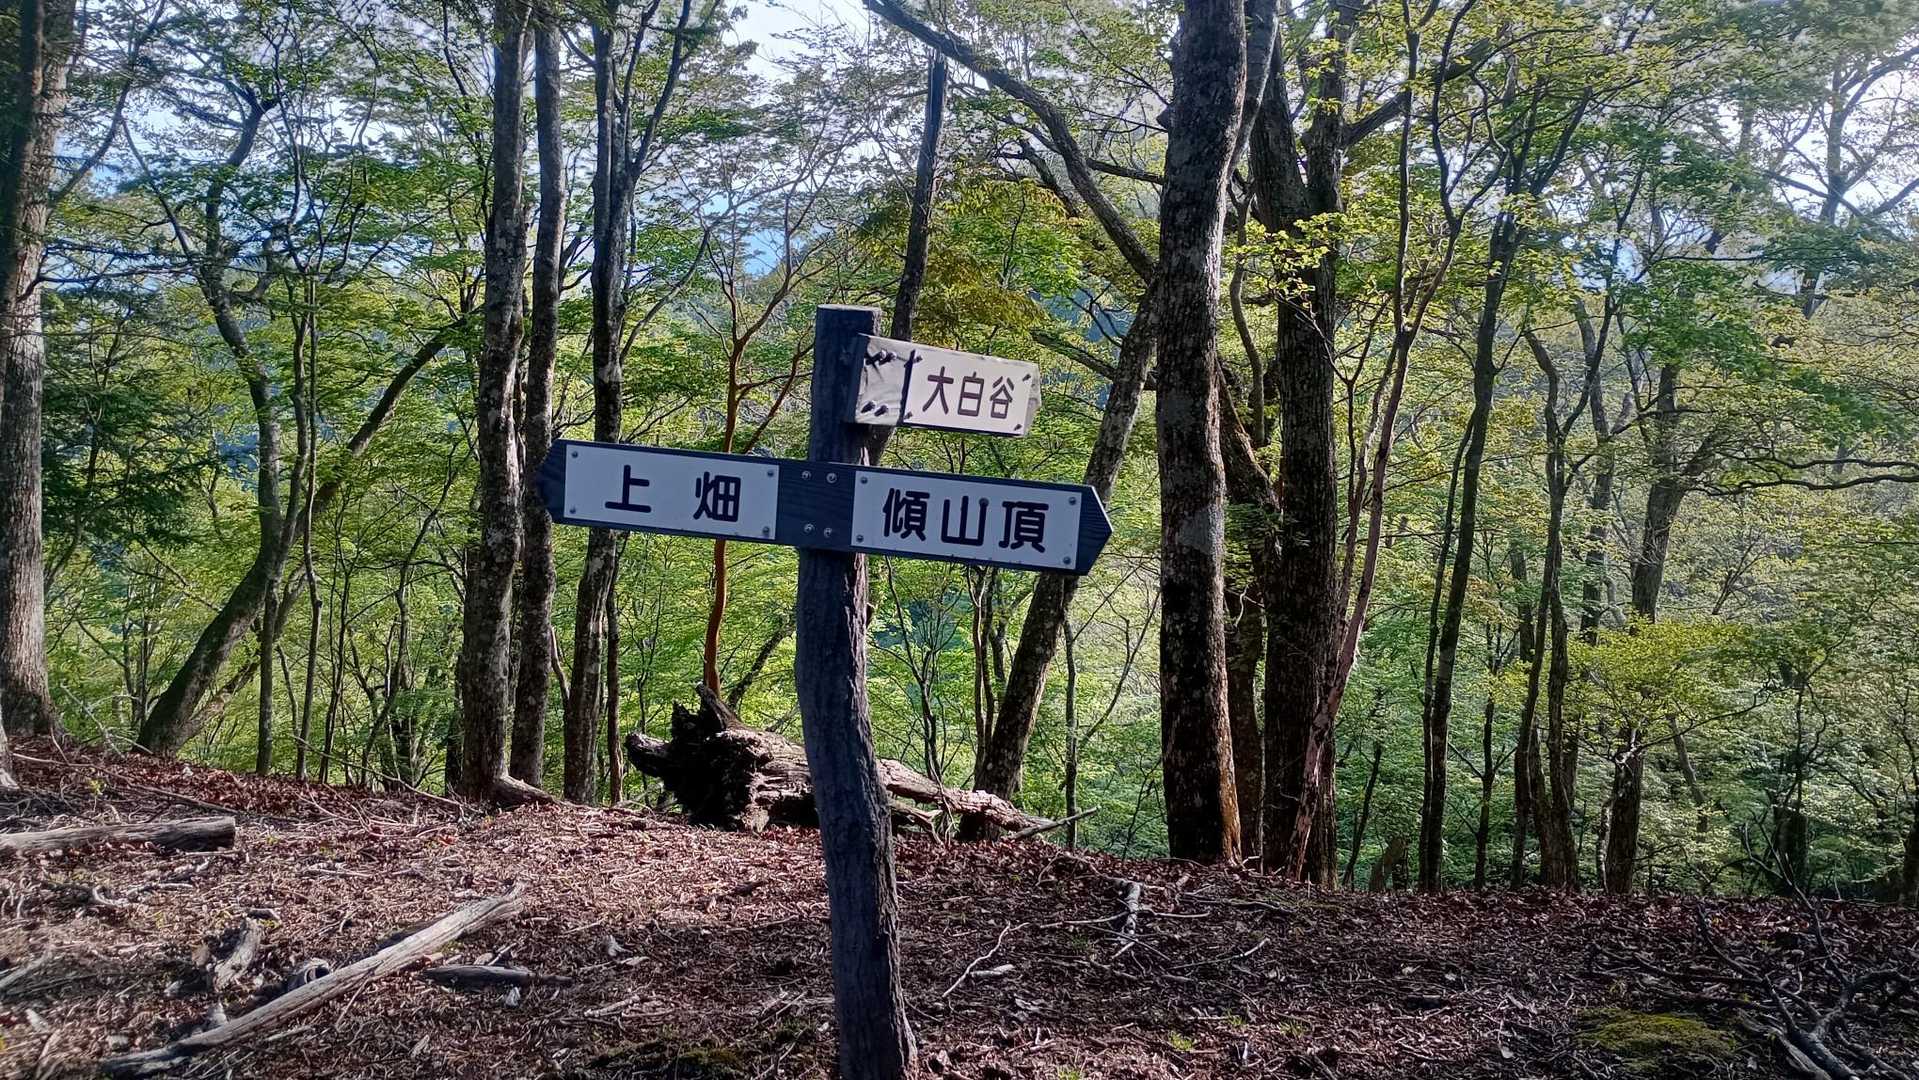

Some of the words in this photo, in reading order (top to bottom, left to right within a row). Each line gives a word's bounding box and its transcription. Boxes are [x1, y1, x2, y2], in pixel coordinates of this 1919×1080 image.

[922, 367, 1015, 419] 大白谷
[605, 465, 741, 522] 上畑
[883, 488, 1049, 553] 傾山頂
